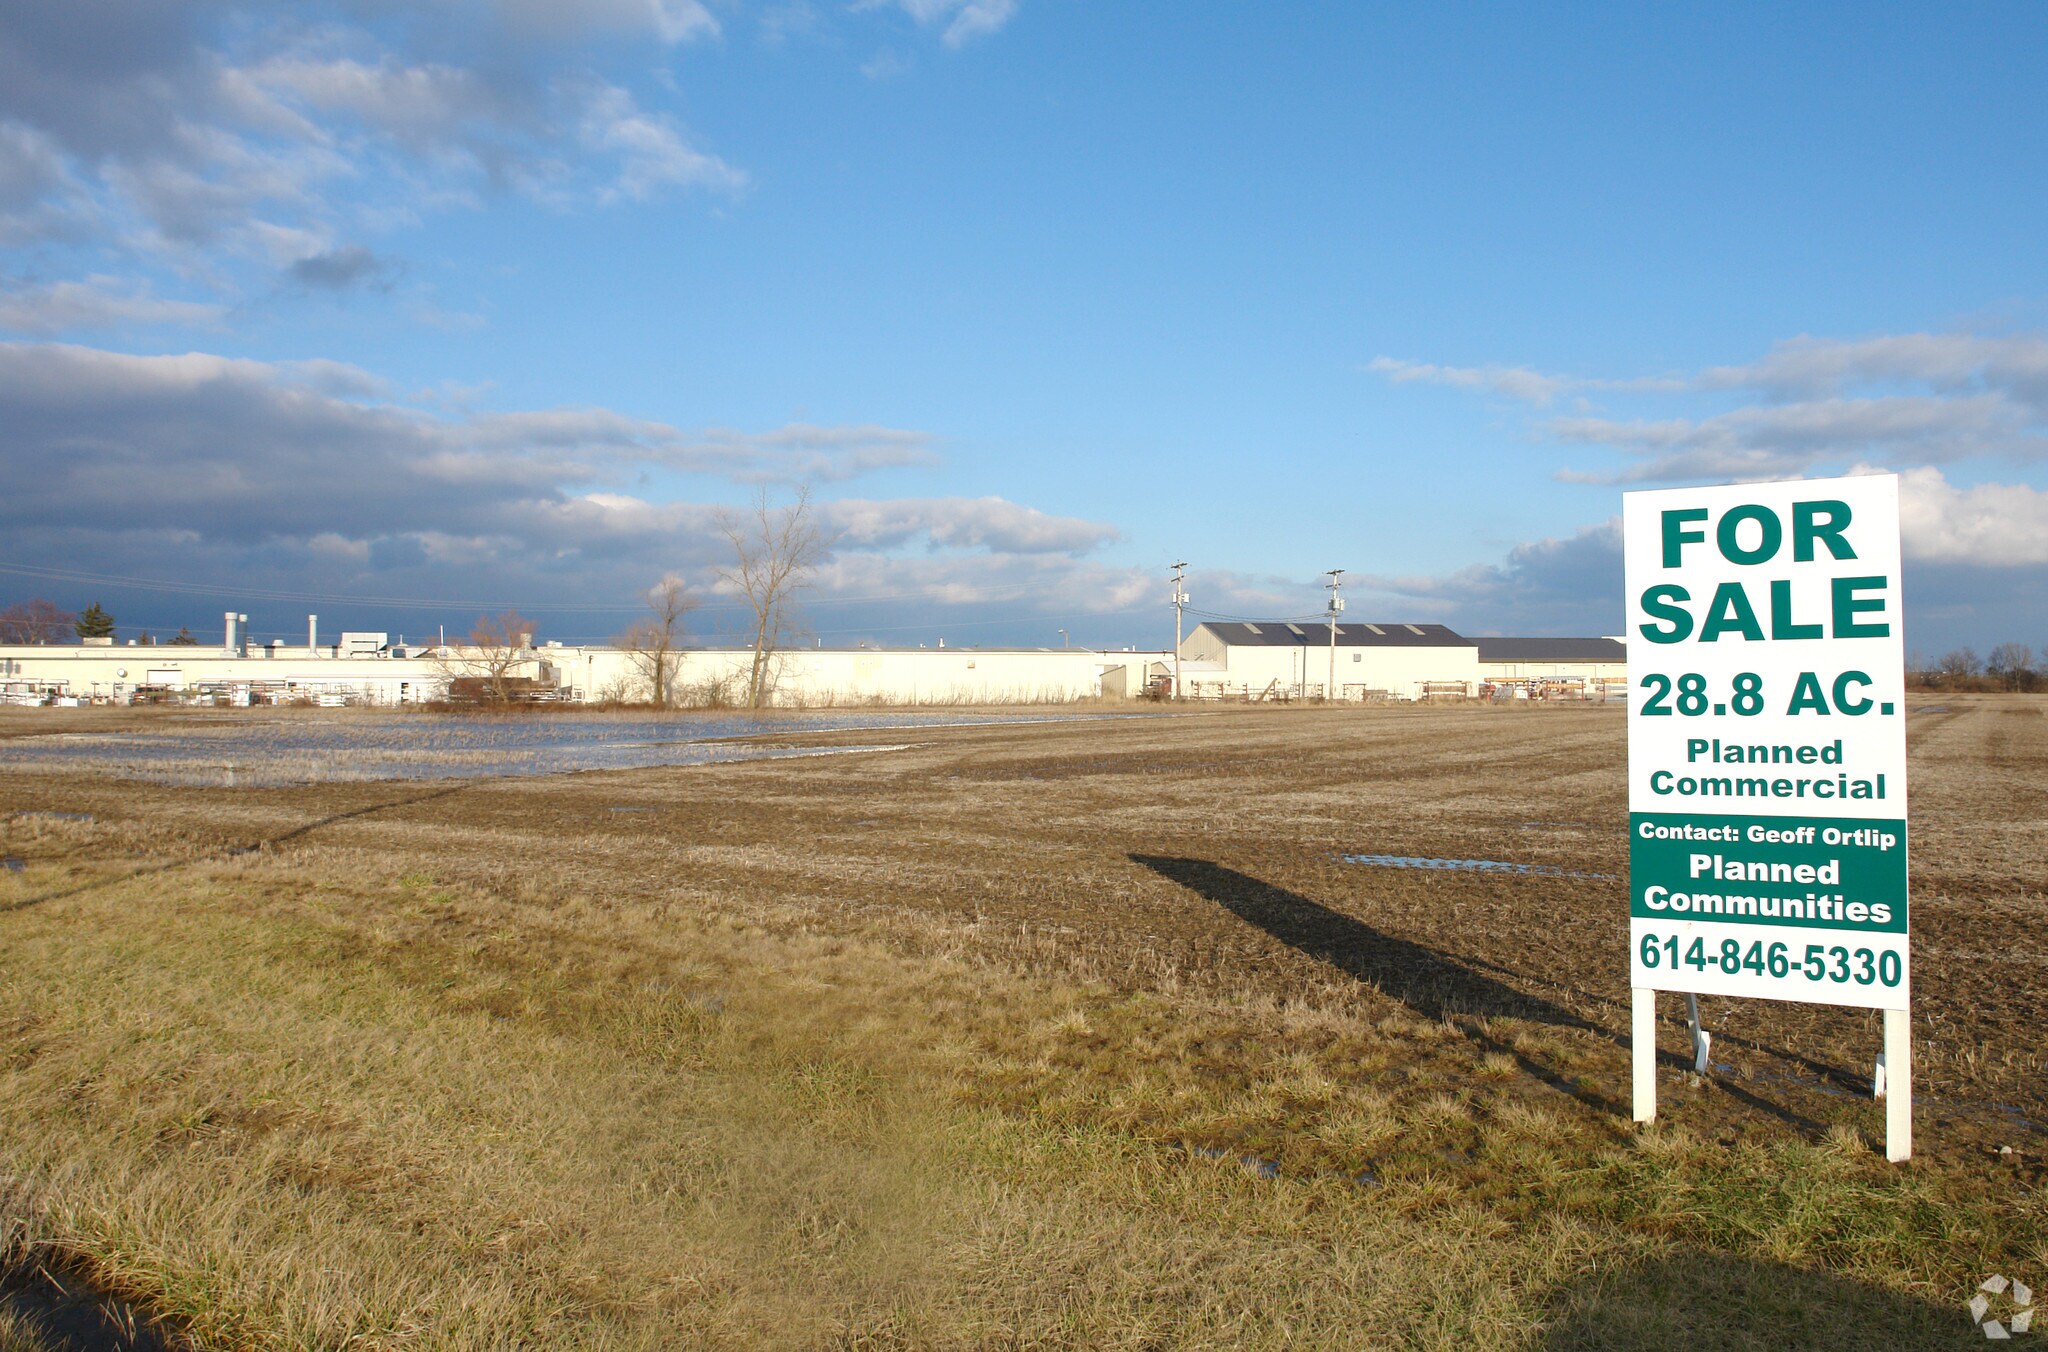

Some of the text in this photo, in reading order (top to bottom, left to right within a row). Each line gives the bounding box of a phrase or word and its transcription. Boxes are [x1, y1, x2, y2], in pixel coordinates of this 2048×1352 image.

[1661, 500, 1859, 568] FOR
[1638, 575, 1890, 644] SALE
[1639, 670, 1895, 716] 28.8 AC.
[1687, 738, 1843, 764] Planned
[1650, 770, 1886, 800] Commercial
[1638, 821, 1896, 851] Contact: Geoff Ortlip
[1689, 853, 1840, 885] Planned
[1643, 885, 1892, 924] Communities
[1640, 933, 1902, 988] 614-846-5330
